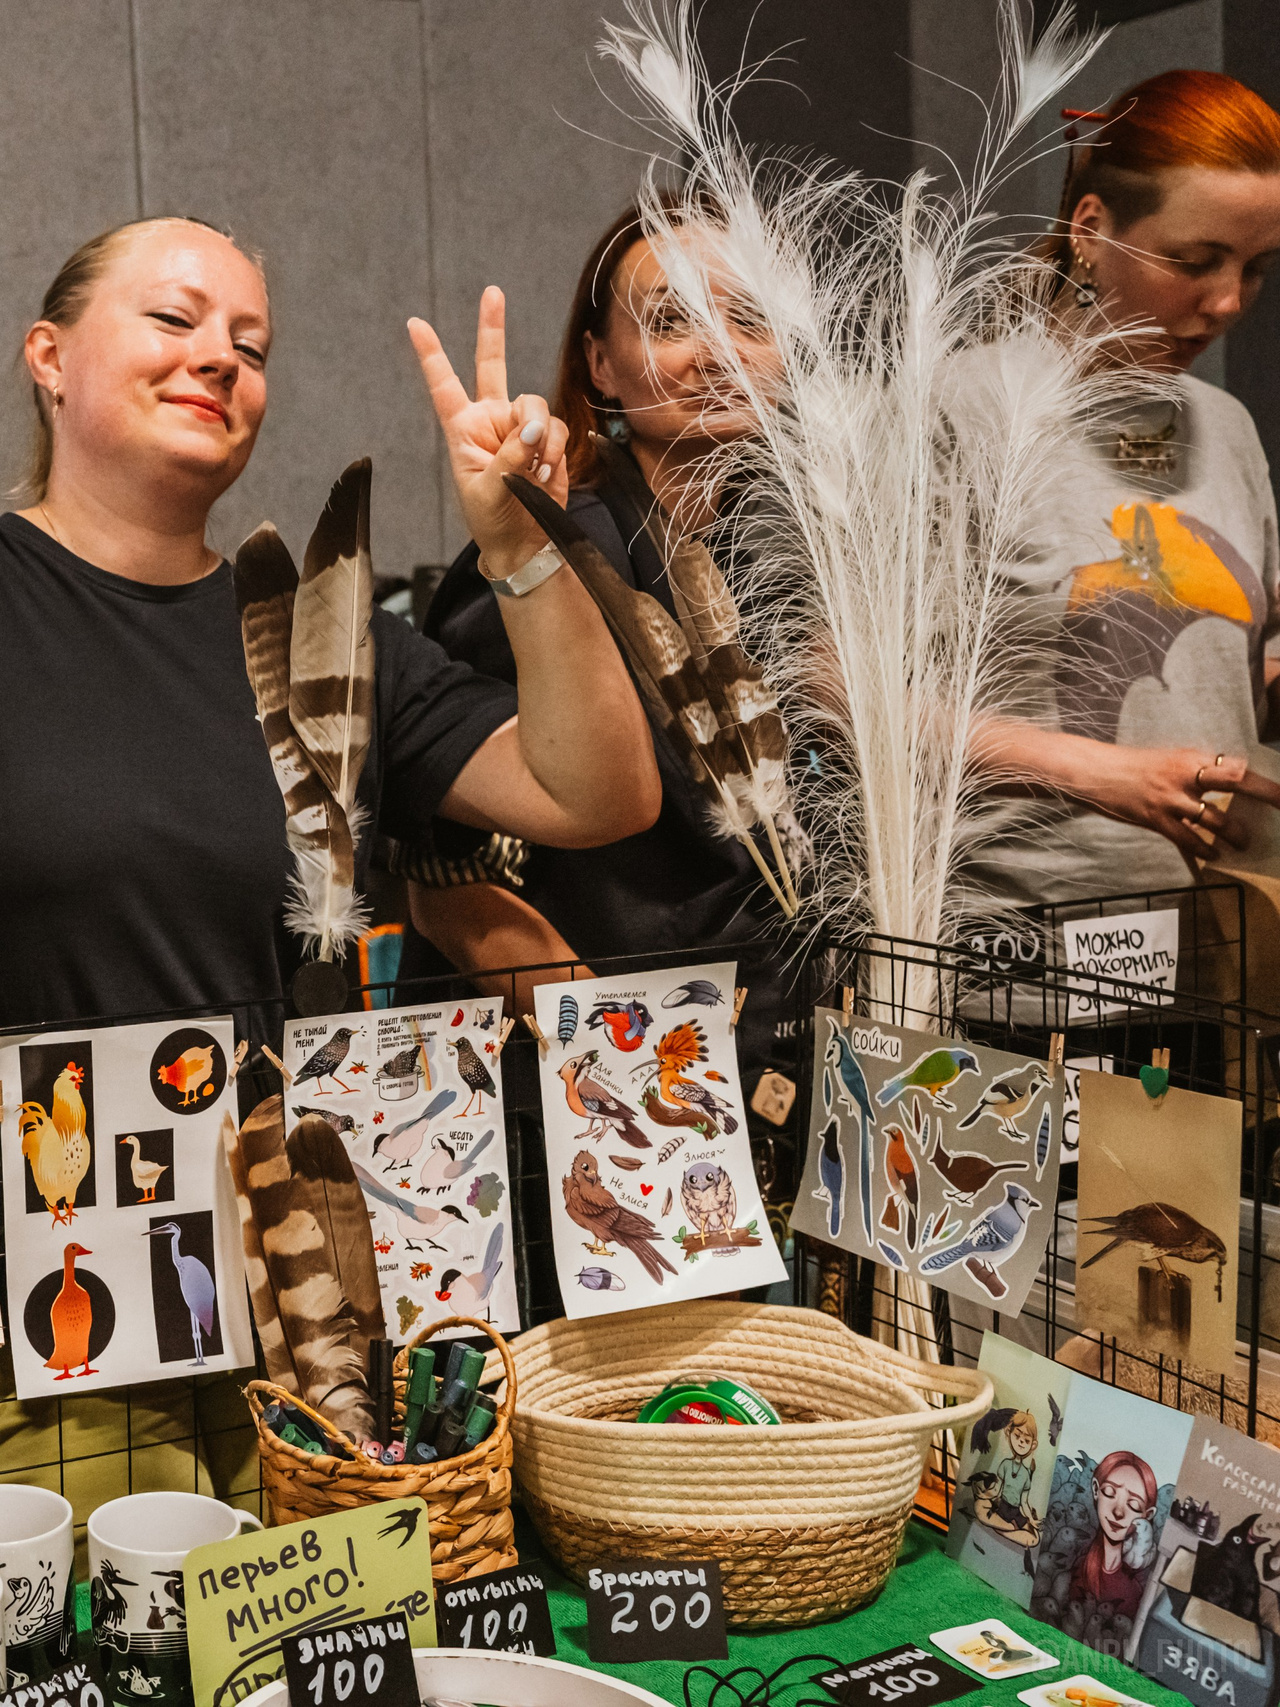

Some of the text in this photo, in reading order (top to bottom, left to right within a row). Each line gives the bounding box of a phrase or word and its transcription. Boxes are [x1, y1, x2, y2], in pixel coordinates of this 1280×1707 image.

[1075, 929, 1145, 957] МОЖНО
[1073, 950, 1176, 981] ПОКОРМИТЬ
[595, 991, 647, 1001] Утепляемся
[293, 1025, 327, 1038] НЕ ТЫКАЙ
[295, 1039, 315, 1048] МЕНЯ
[593, 1062, 613, 1076] Для
[591, 1073, 624, 1095] заначки
[449, 1131, 474, 1141] ЧЕСАТЬ
[456, 1142, 469, 1151] ТУТ
[684, 1150, 716, 1163] Злюся
[610, 1176, 624, 1190] Не
[619, 1192, 649, 1210] злися
[198, 1530, 322, 1599] перьев
[610, 1591, 711, 1634] 200
[460, 1602, 528, 1649] 100
[308, 1653, 385, 1705] 100
[868, 1668, 940, 1701] 100
[1164, 1646, 1236, 1706] ЗЯВА
